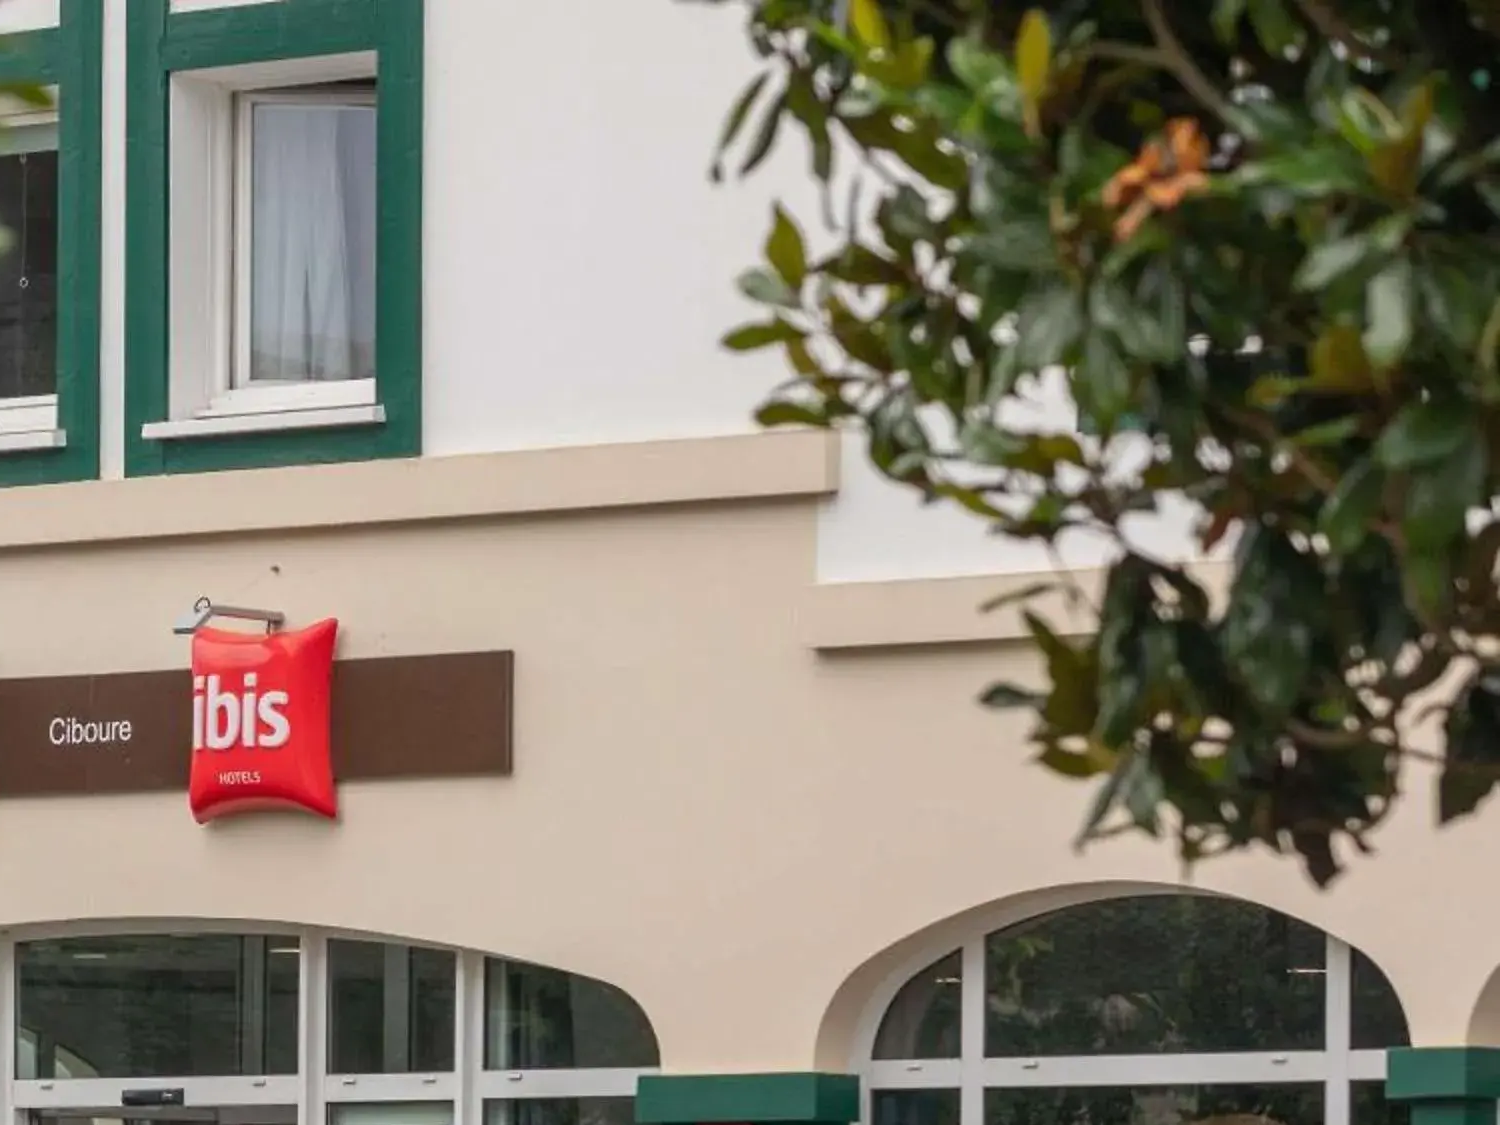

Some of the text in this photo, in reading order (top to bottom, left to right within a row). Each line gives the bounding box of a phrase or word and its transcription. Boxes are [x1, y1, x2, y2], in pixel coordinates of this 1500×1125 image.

[193, 671, 291, 750] ibis
[48, 716, 132, 745] Ciboure
[219, 770, 261, 785] HOTELS
